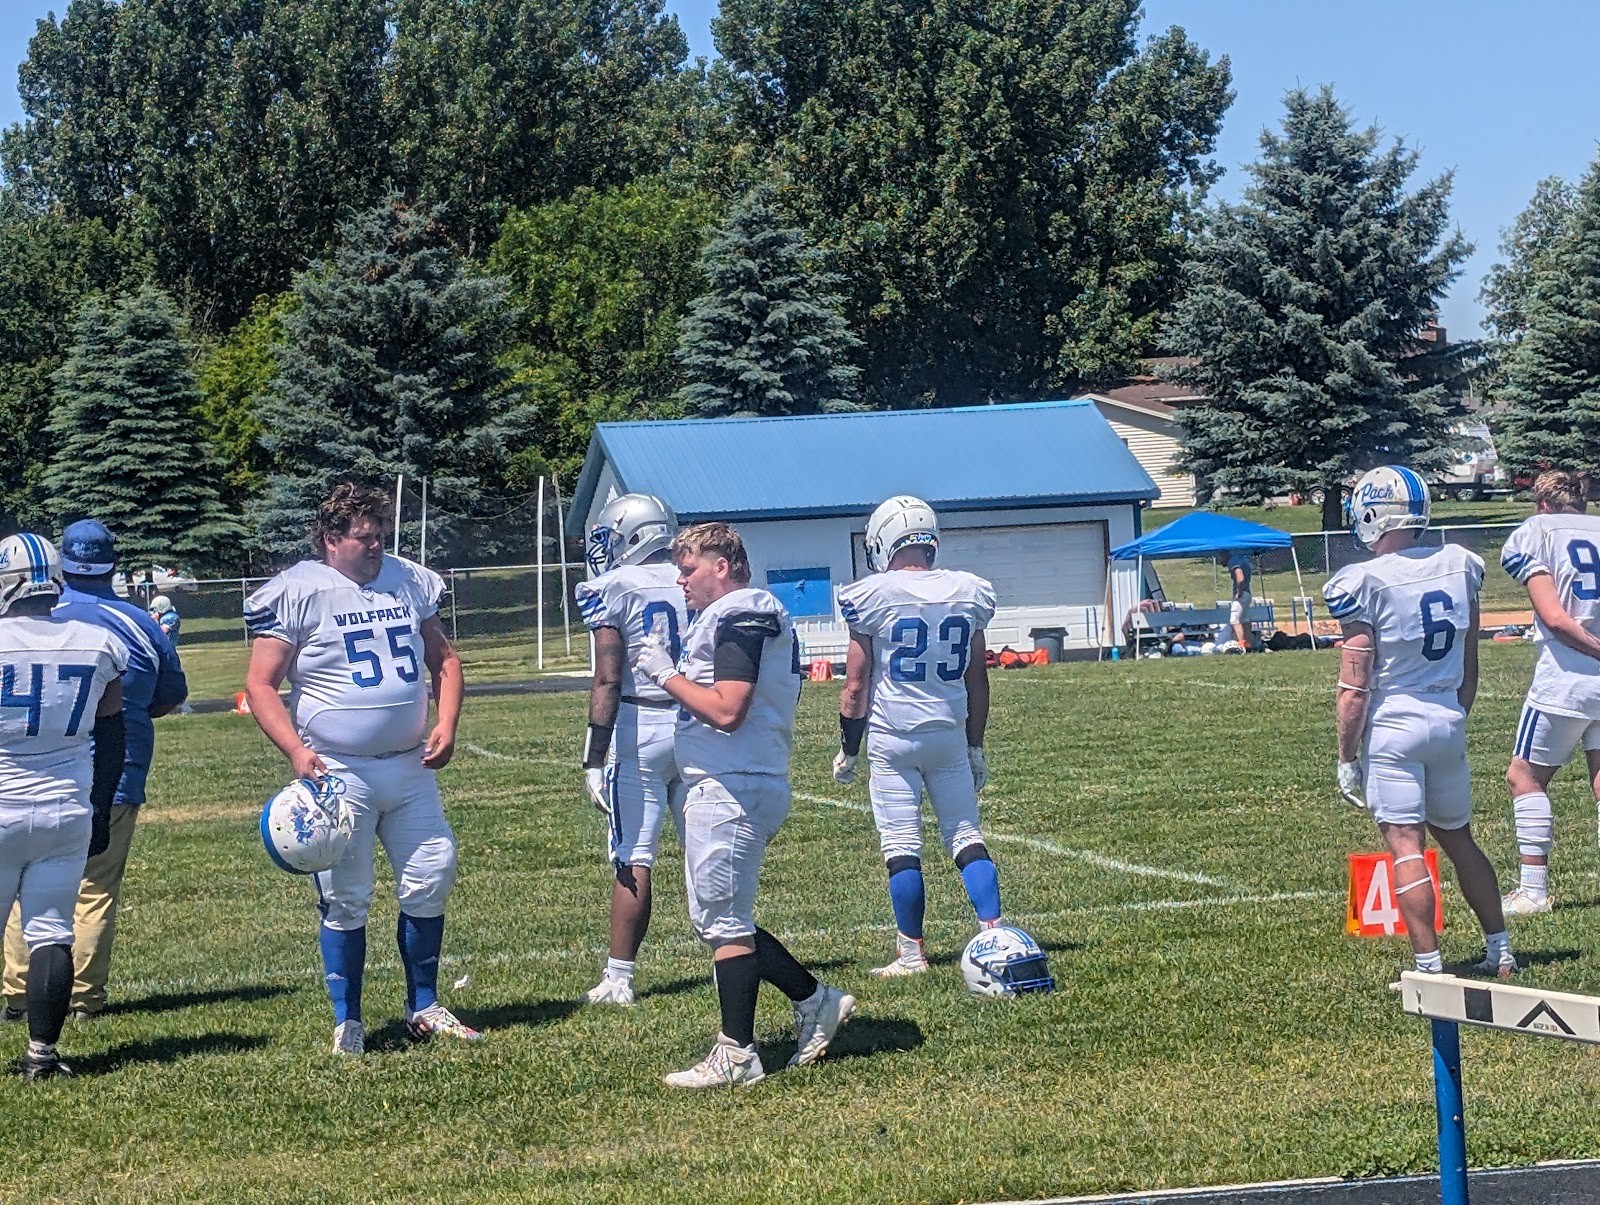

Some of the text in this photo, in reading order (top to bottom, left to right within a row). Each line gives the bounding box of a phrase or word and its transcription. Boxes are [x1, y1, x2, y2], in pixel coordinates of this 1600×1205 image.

[1359, 483, 1395, 502] Pack
[1567, 539, 1600, 600] 9
[333, 606, 411, 627] WOLFPACK
[1420, 590, 1456, 661] 6
[343, 624, 419, 688] 55
[811, 662, 828, 681] 50
[890, 615, 970, 681] 23
[0, 664, 97, 736] 47
[966, 936, 1000, 955] Pack
